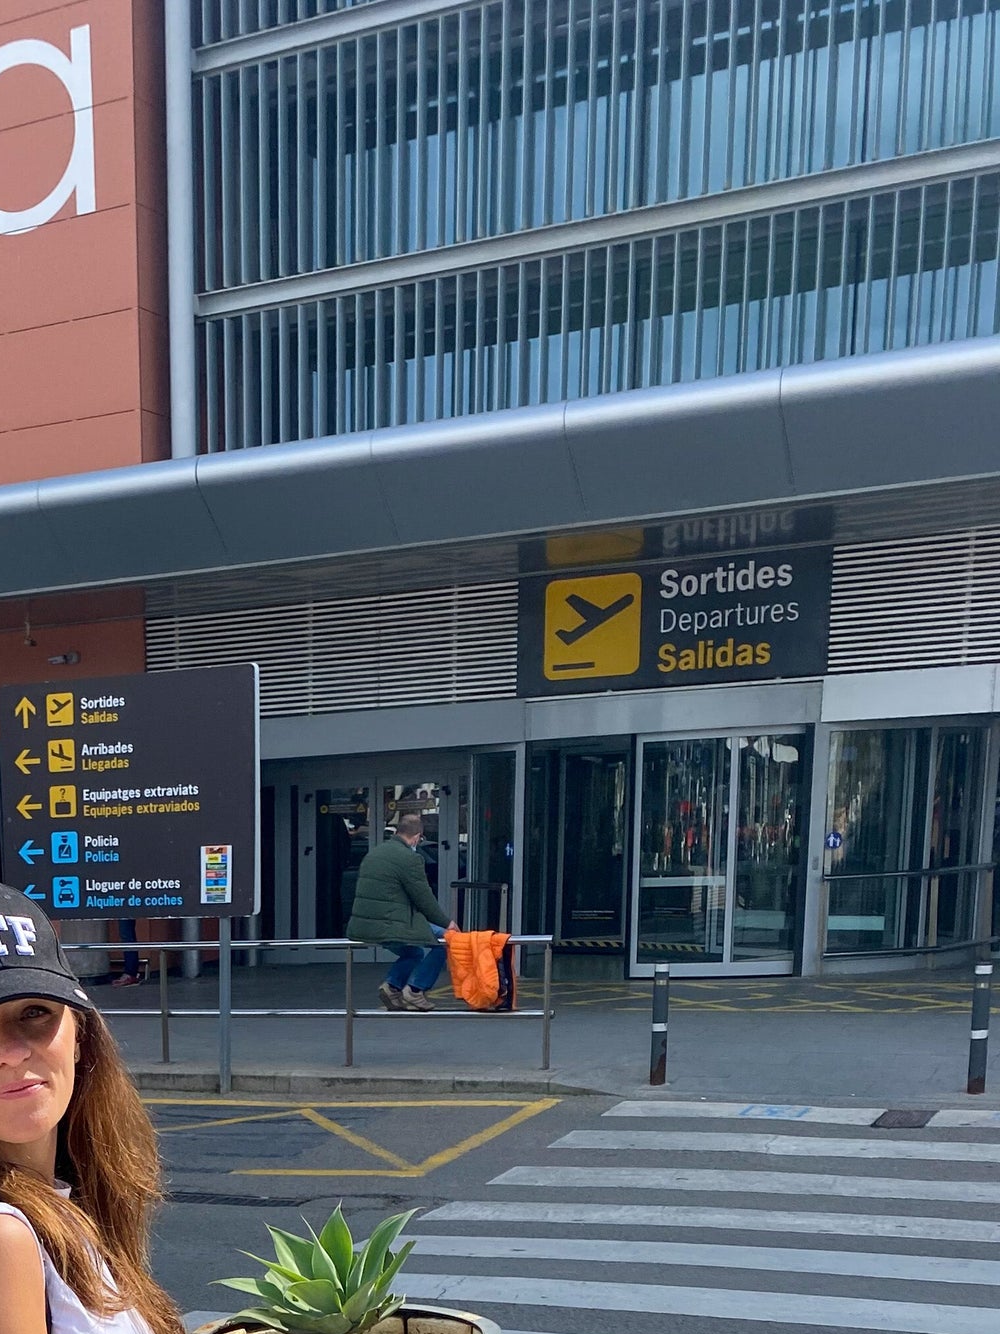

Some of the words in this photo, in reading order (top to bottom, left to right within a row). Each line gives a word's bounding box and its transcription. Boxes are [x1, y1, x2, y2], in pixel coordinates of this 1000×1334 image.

[659, 561, 793, 599] Sortides
[660, 601, 799, 635] Departures
[657, 638, 771, 673] Salidas
[80, 695, 125, 710] Sortides
[81, 711, 118, 724] Salidas
[81, 742, 133, 756] Arribades
[82, 757, 130, 772] Llegadas
[82, 788, 141, 803] Equipatges
[144, 784, 199, 798] extraviats
[83, 804, 133, 818] Equipajes
[136, 800, 200, 814] extraviados
[84, 835, 119, 847] Policia
[85, 851, 119, 863] Policía
[85, 879, 126, 893] Lloguer
[128, 878, 142, 891] de
[145, 878, 180, 890] cotxes
[86, 895, 125, 909] Alquiler
[128, 895, 141, 907] de
[145, 894, 183, 907] coches
